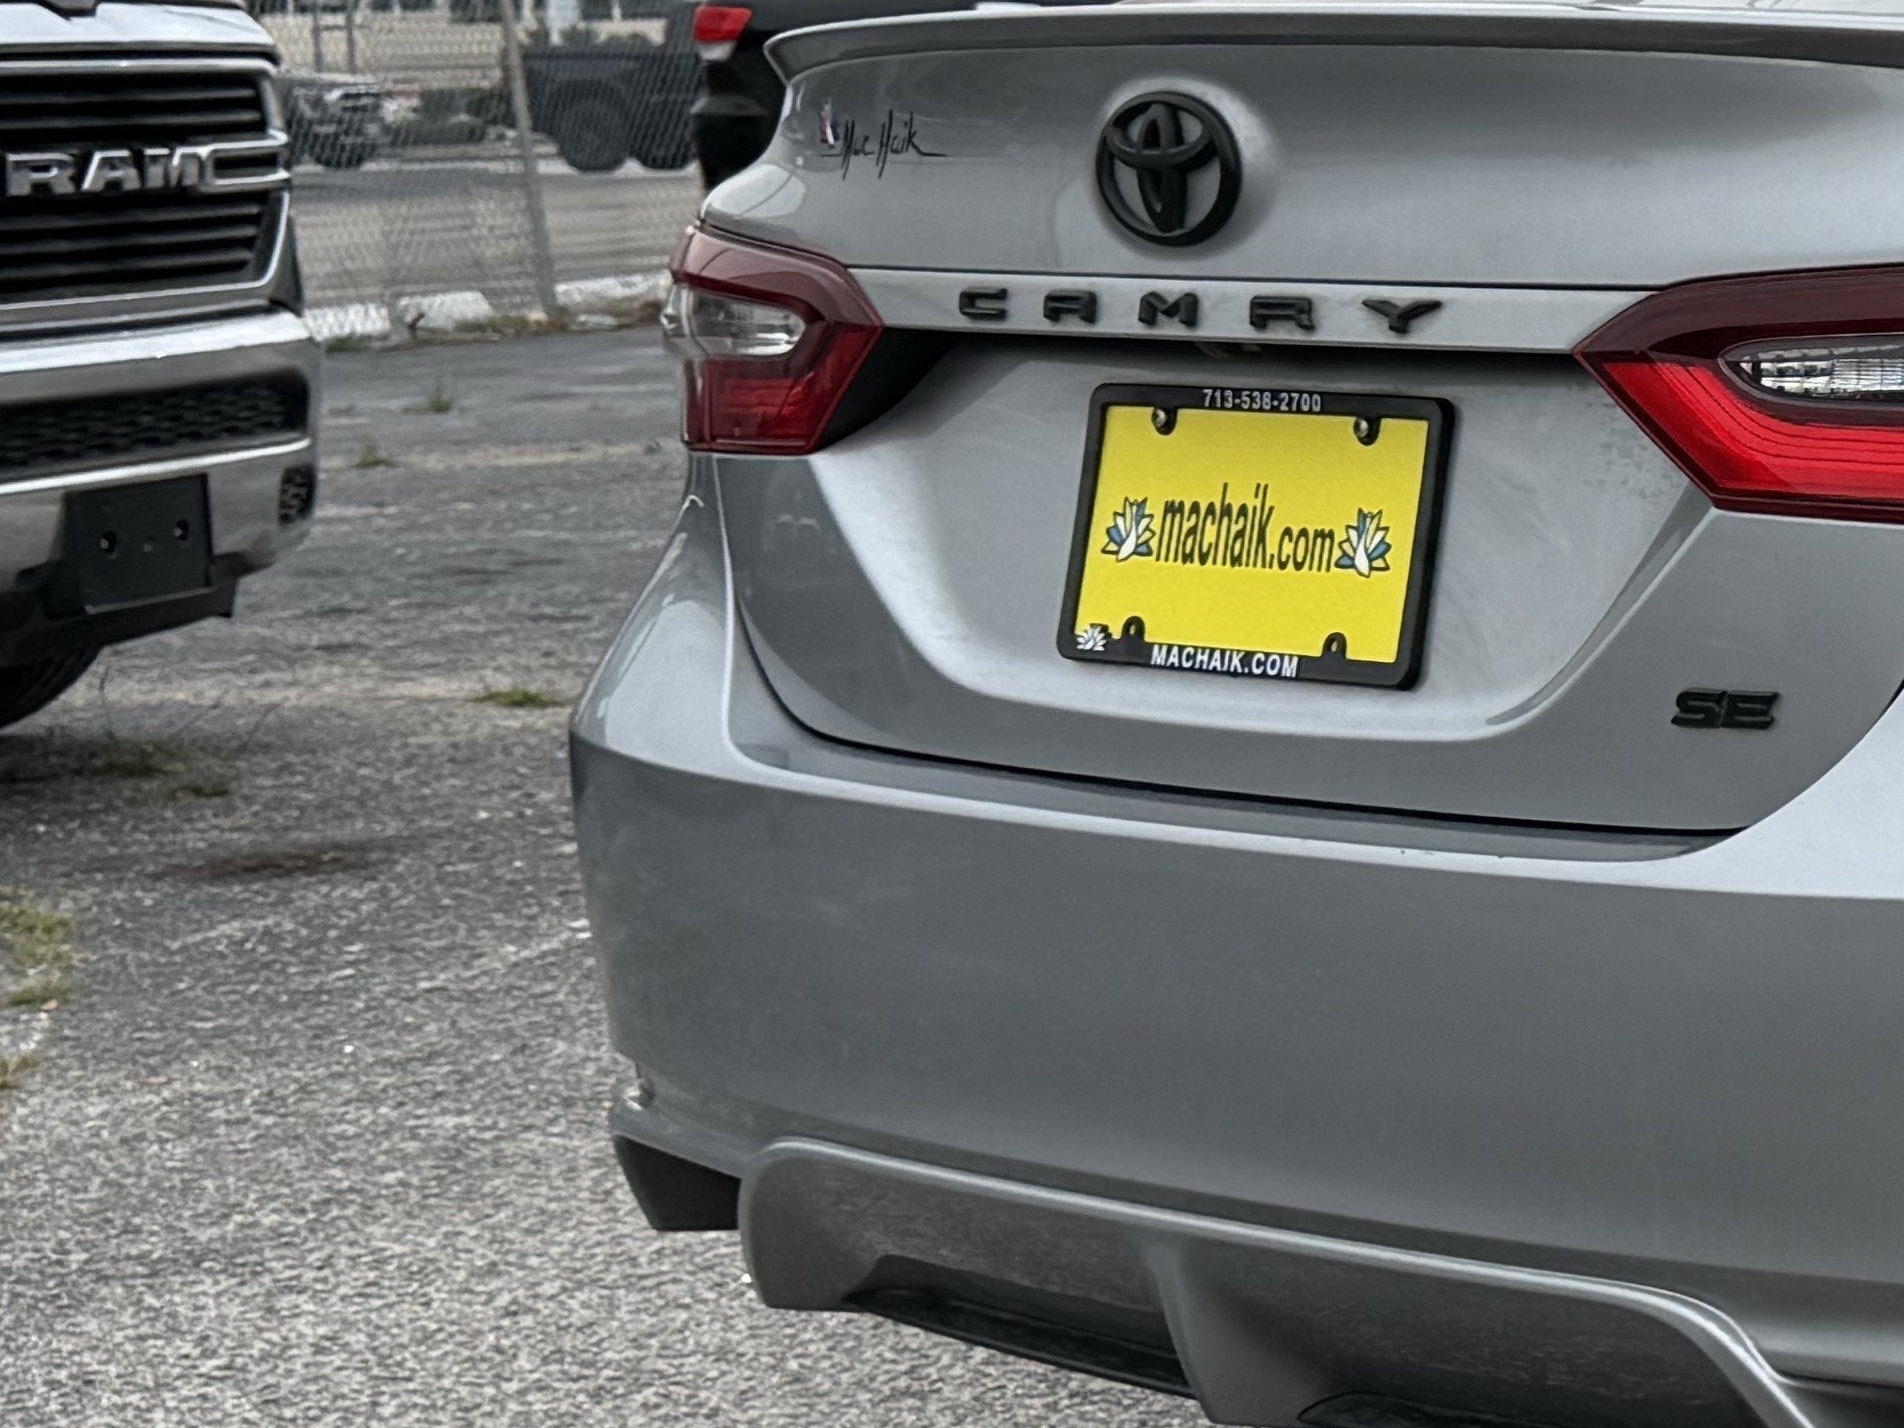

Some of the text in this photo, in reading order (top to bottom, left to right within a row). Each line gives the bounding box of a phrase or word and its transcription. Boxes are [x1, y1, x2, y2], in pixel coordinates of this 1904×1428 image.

[5, 148, 203, 198] RAM
[958, 287, 1443, 335] CAMRY
[1155, 482, 1335, 573] machaik.com
[1150, 644, 1299, 679] MACHAIK.COM
[1671, 687, 1780, 730] SE
